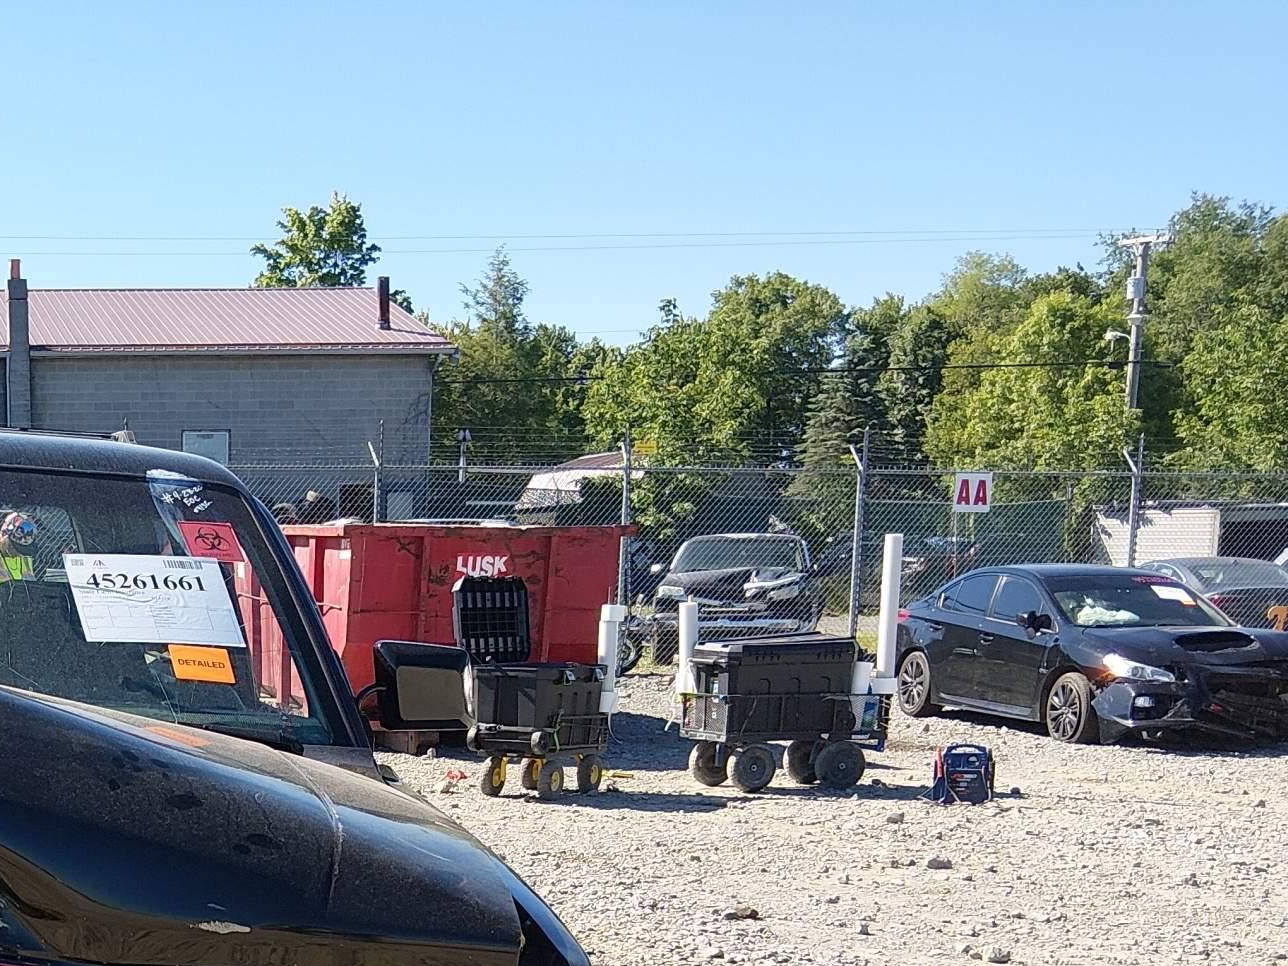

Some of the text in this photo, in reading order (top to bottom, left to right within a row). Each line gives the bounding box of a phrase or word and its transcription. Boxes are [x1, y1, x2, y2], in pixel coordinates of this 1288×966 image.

[956, 479, 988, 506] AA
[456, 555, 509, 577] LUSK
[86, 573, 207, 592] 45261661
[177, 658, 226, 669] DETAILED
